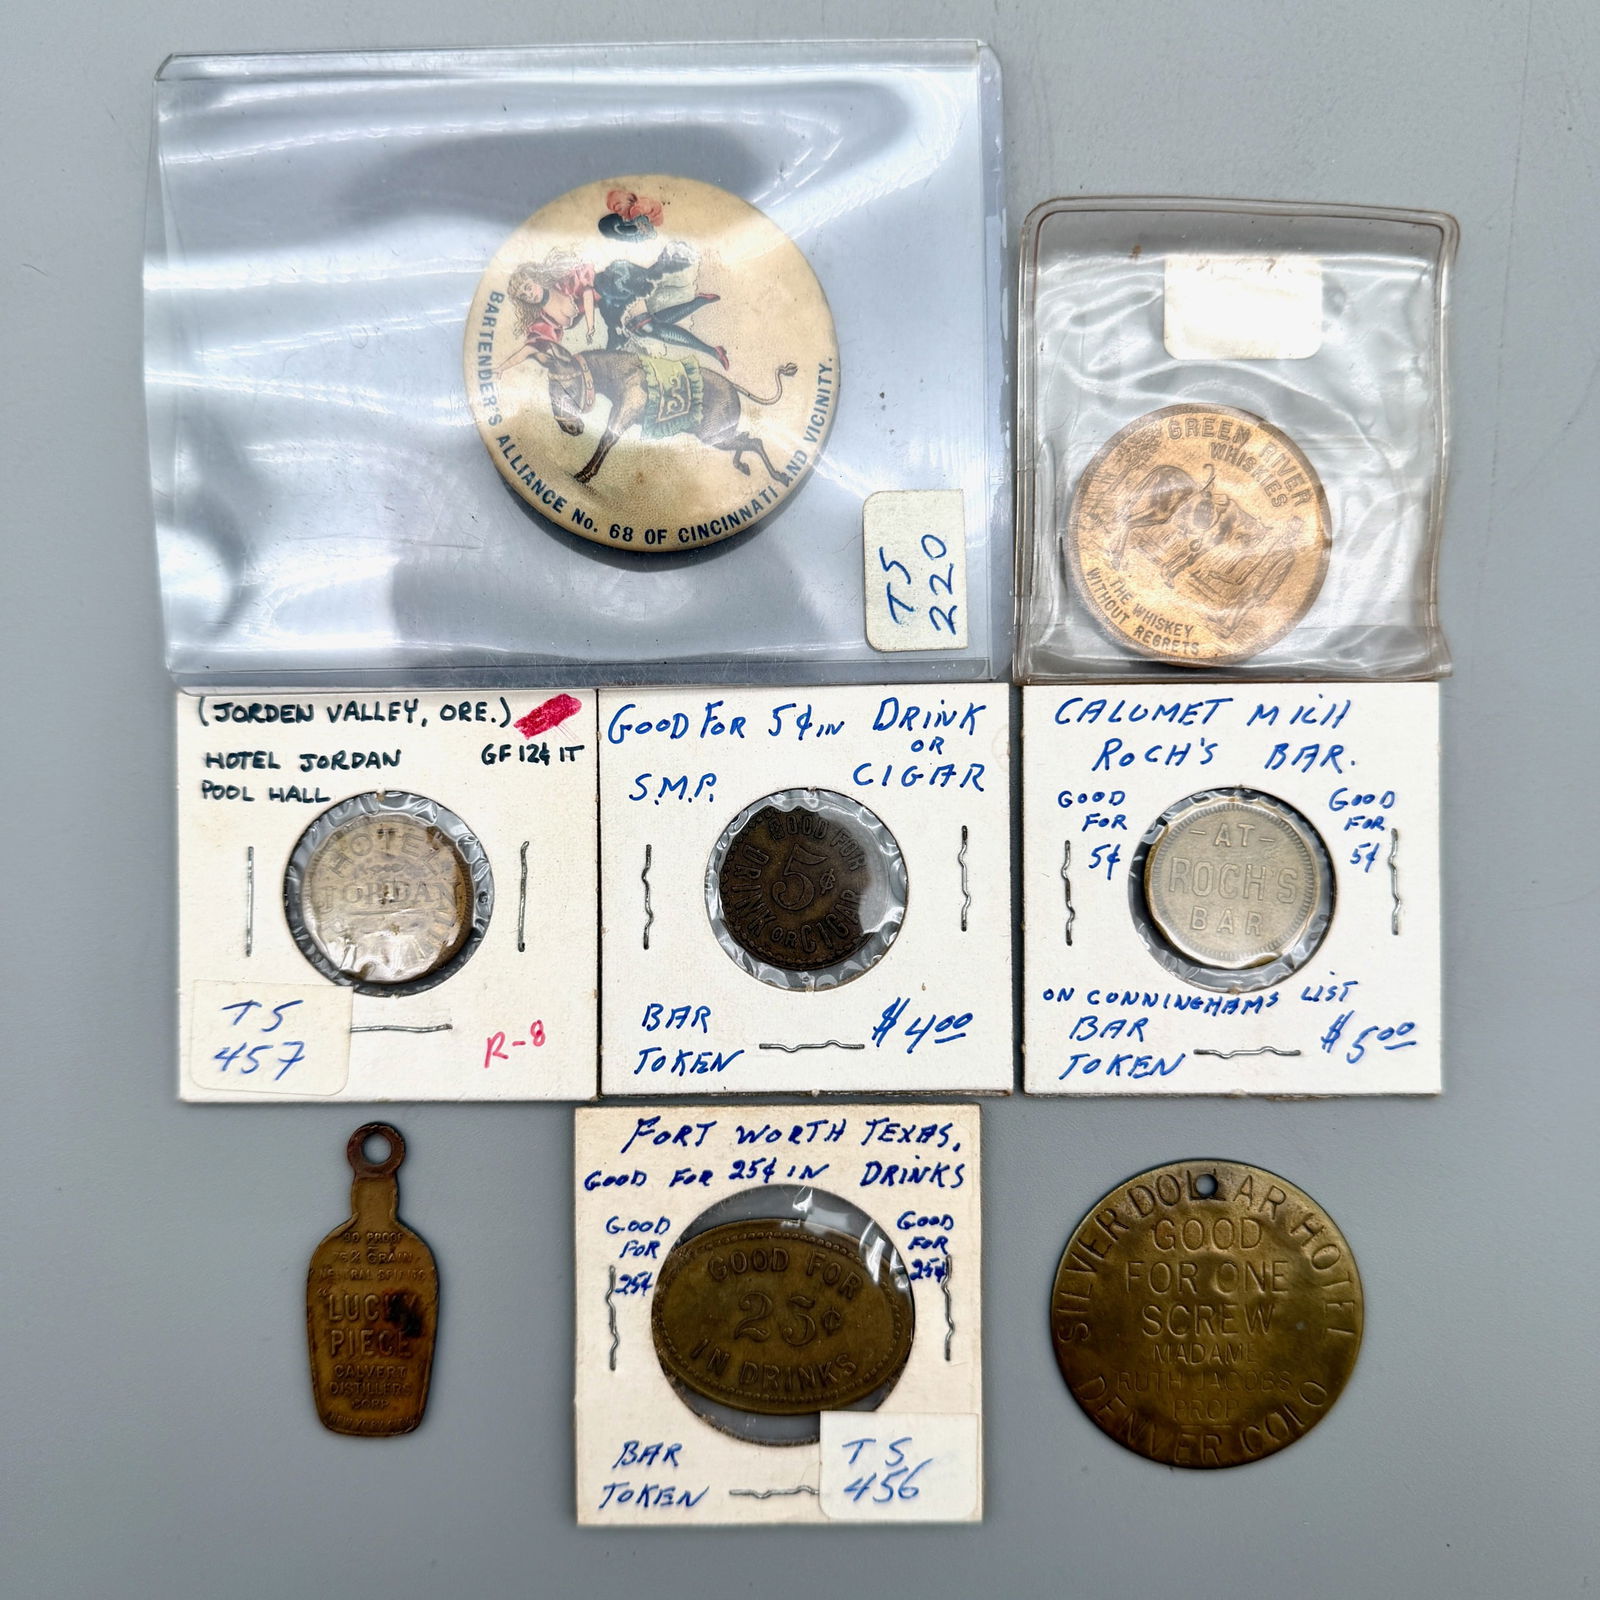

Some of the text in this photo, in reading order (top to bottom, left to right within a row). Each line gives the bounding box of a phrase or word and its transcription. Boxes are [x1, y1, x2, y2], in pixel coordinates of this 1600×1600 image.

[475, 290, 505, 427] BARTENDER'S
[496, 435, 568, 514] ALLIANCE
[609, 523, 633, 543] 68
[645, 528, 668, 545] OF
[678, 485, 779, 544] CINCINNATI
[784, 451, 807, 487] AND
[804, 357, 834, 443] VICINITY.
[1168, 419, 1312, 507] GREEN RIVER
[1208, 442, 1288, 508] WHISKIES
[921, 534, 958, 635] 220
[1086, 568, 1199, 656] WITHOUT REGRETS
[1110, 578, 1194, 638] THE WHISKEY
[199, 697, 511, 727] (JORDEN VALLEY, ORE.)
[608, 703, 690, 744] GOOD
[872, 697, 986, 736] DRINK
[1055, 698, 1233, 726] CALUMET
[205, 750, 401, 772] HOTEL JORDAN
[910, 737, 944, 755] OR
[1264, 743, 1355, 774] BAR.
[202, 780, 331, 803] POOL HALL
[853, 763, 985, 792] CIGAR
[1057, 791, 1125, 808] GOOD
[1329, 788, 1395, 811] GOOD
[1082, 814, 1128, 831] FOR
[1344, 816, 1385, 831] FOR
[326, 827, 444, 875] HOTEL
[768, 813, 867, 872] GOOD FOR
[1350, 843, 1380, 872] 5¢
[1088, 844, 1121, 880] 5¢
[1170, 856, 1299, 904] ROCH'S
[732, 844, 865, 954] DRINK OR CIGAR
[1190, 905, 1263, 937] BAR
[1043, 987, 1074, 1002] ON
[1302, 972, 1358, 1002] LIST
[642, 1004, 711, 1033] BAR
[1069, 1016, 1149, 1042] BAR
[485, 1020, 546, 1068] R-8
[214, 1041, 305, 1081] 457
[634, 1049, 745, 1076] TOKEN
[1059, 1053, 1187, 1080] TOKEN
[621, 1116, 962, 1153] FORT WORTH TEXAS,
[584, 1155, 964, 1191] GOOD FOR 25¢ IN DRINKS
[606, 1215, 671, 1234] GOOD
[897, 1210, 954, 1230] GOOD
[1152, 1218, 1263, 1251] GOOD
[619, 1240, 660, 1258] FOR
[908, 1236, 948, 1252] FOR
[615, 1272, 654, 1297] 25¢
[708, 1246, 863, 1300] GOOD FOR
[1057, 1208, 1130, 1342] SILVER
[1125, 1260, 1289, 1295] FOR ONE
[1142, 1303, 1277, 1338] SCREW
[691, 1339, 857, 1390] IN DRINKS
[1153, 1343, 1257, 1365] MADAME
[334, 1363, 408, 1378] CALVERT
[1117, 1371, 1294, 1393] RUTH JACOBS
[329, 1383, 413, 1396] DISTILLERS
[1076, 1375, 1224, 1466] DENVER
[612, 1441, 683, 1469] BAR
[599, 1482, 710, 1509] TOKEN
[844, 1457, 933, 1504] 456
